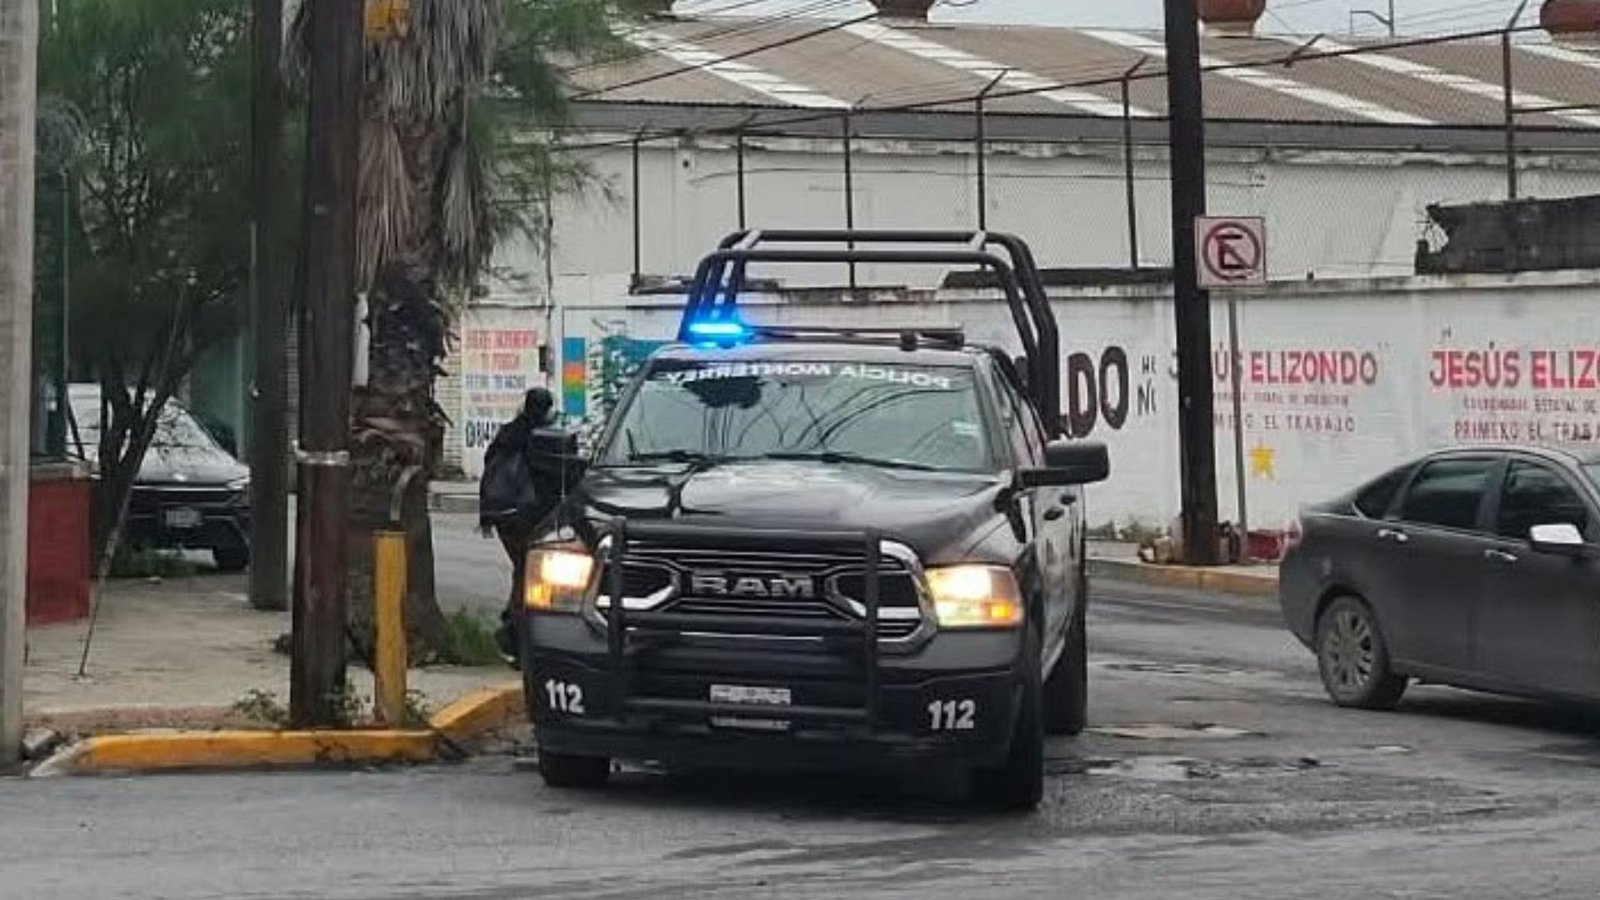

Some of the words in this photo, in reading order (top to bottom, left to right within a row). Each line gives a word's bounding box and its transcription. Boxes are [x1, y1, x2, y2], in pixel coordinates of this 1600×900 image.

[1251, 351, 1378, 386] ELIZONDO
[1430, 341, 1520, 388] JESÚS
[1531, 350, 1600, 389] ELIZ
[1286, 414, 1355, 433] TRABAJO
[1455, 420, 1519, 440] PRIMERO
[692, 573, 813, 597] RAM
[545, 679, 585, 714] 112
[927, 699, 976, 730] 112
